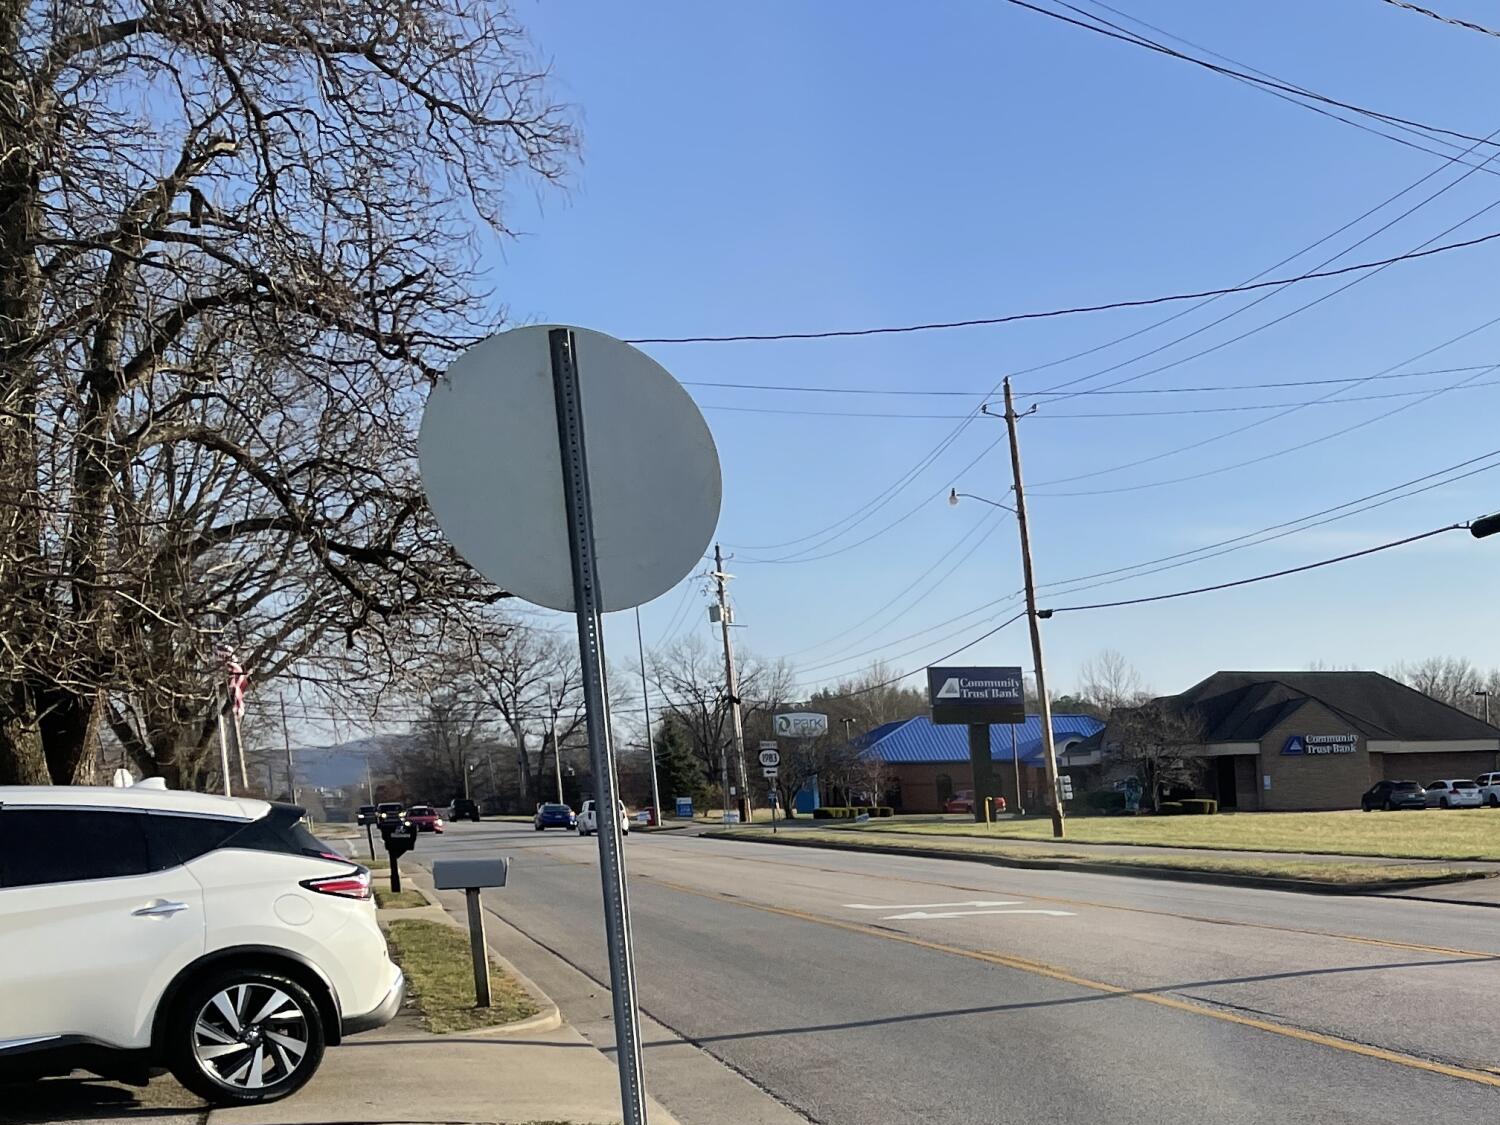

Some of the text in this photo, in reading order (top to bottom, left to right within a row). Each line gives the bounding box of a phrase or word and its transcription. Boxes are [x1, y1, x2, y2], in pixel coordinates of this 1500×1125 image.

[960, 678, 1020, 689] Community
[961, 687, 1019, 698] Trust Bank
[1305, 733, 1359, 743] Community
[1306, 743, 1357, 754] Trust Bank
